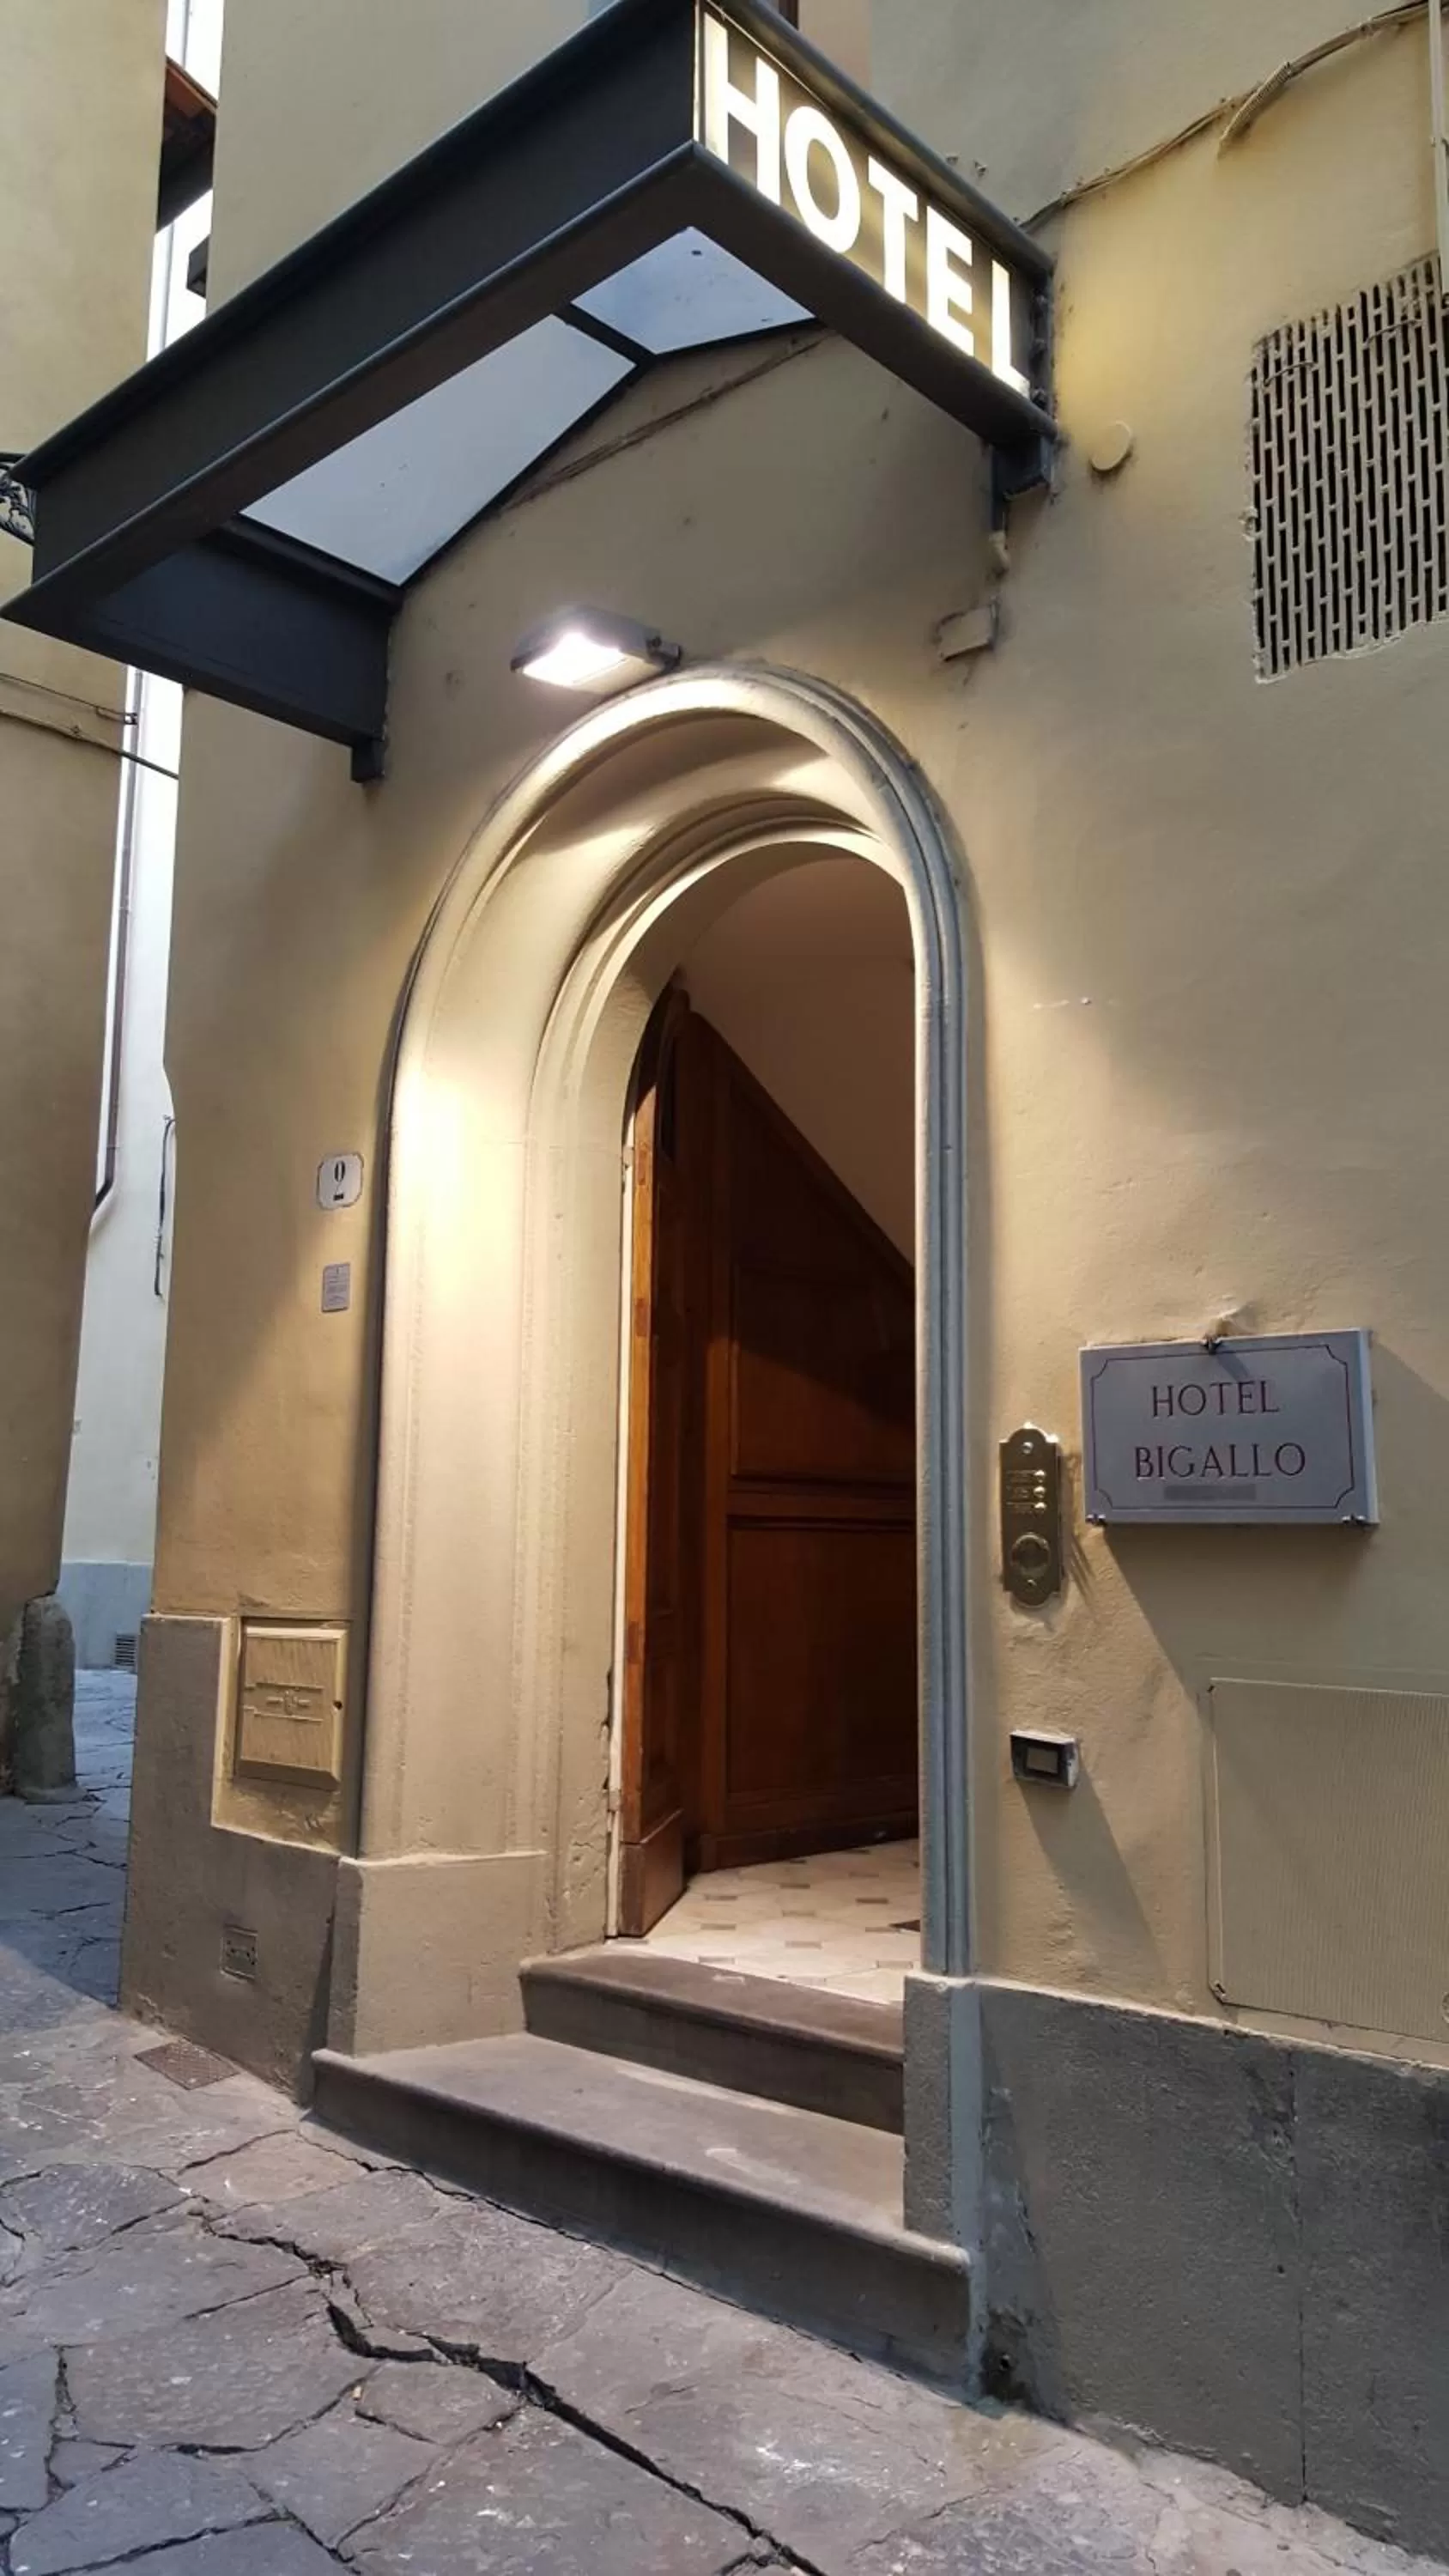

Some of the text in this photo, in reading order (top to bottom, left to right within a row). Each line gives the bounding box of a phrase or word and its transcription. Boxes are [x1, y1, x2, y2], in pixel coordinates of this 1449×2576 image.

[704, 12, 1029, 399] HOTEL
[1152, 1380, 1280, 1418] HOTEL
[1134, 1442, 1306, 1479] BIGALLO
